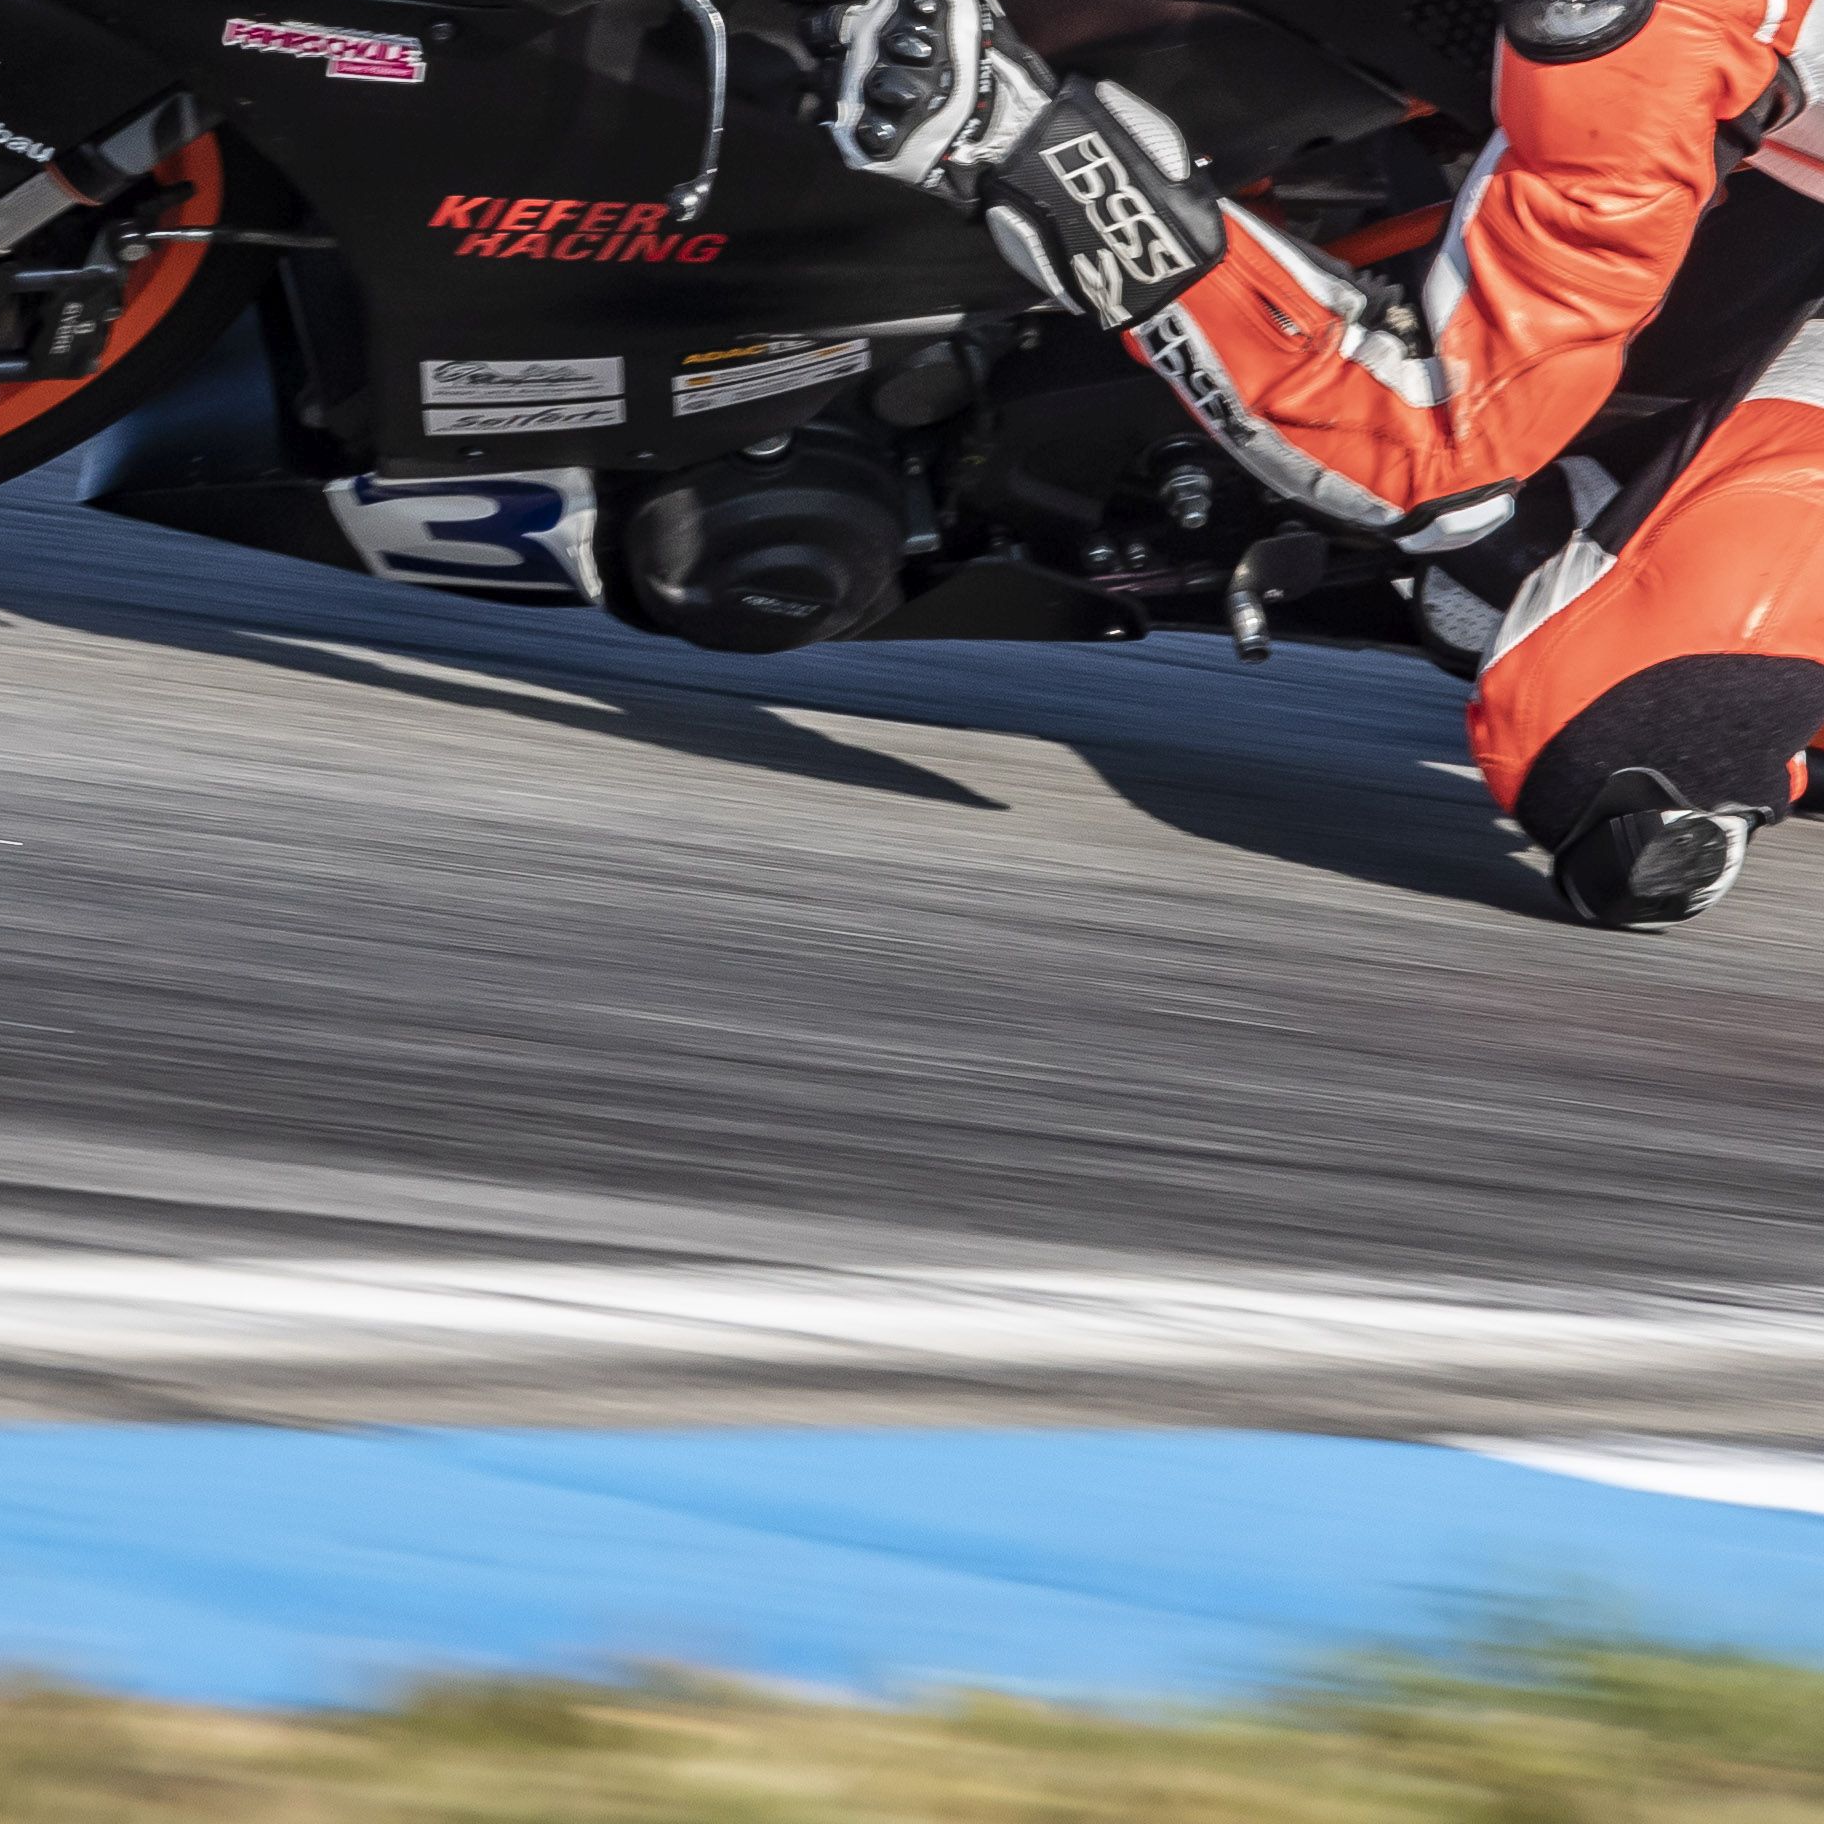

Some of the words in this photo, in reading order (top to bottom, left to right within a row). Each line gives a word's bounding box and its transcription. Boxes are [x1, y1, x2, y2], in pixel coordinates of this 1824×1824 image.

[427, 195, 670, 233] KIEFER
[455, 232, 728, 263] RACING
[356, 476, 576, 589] 3
